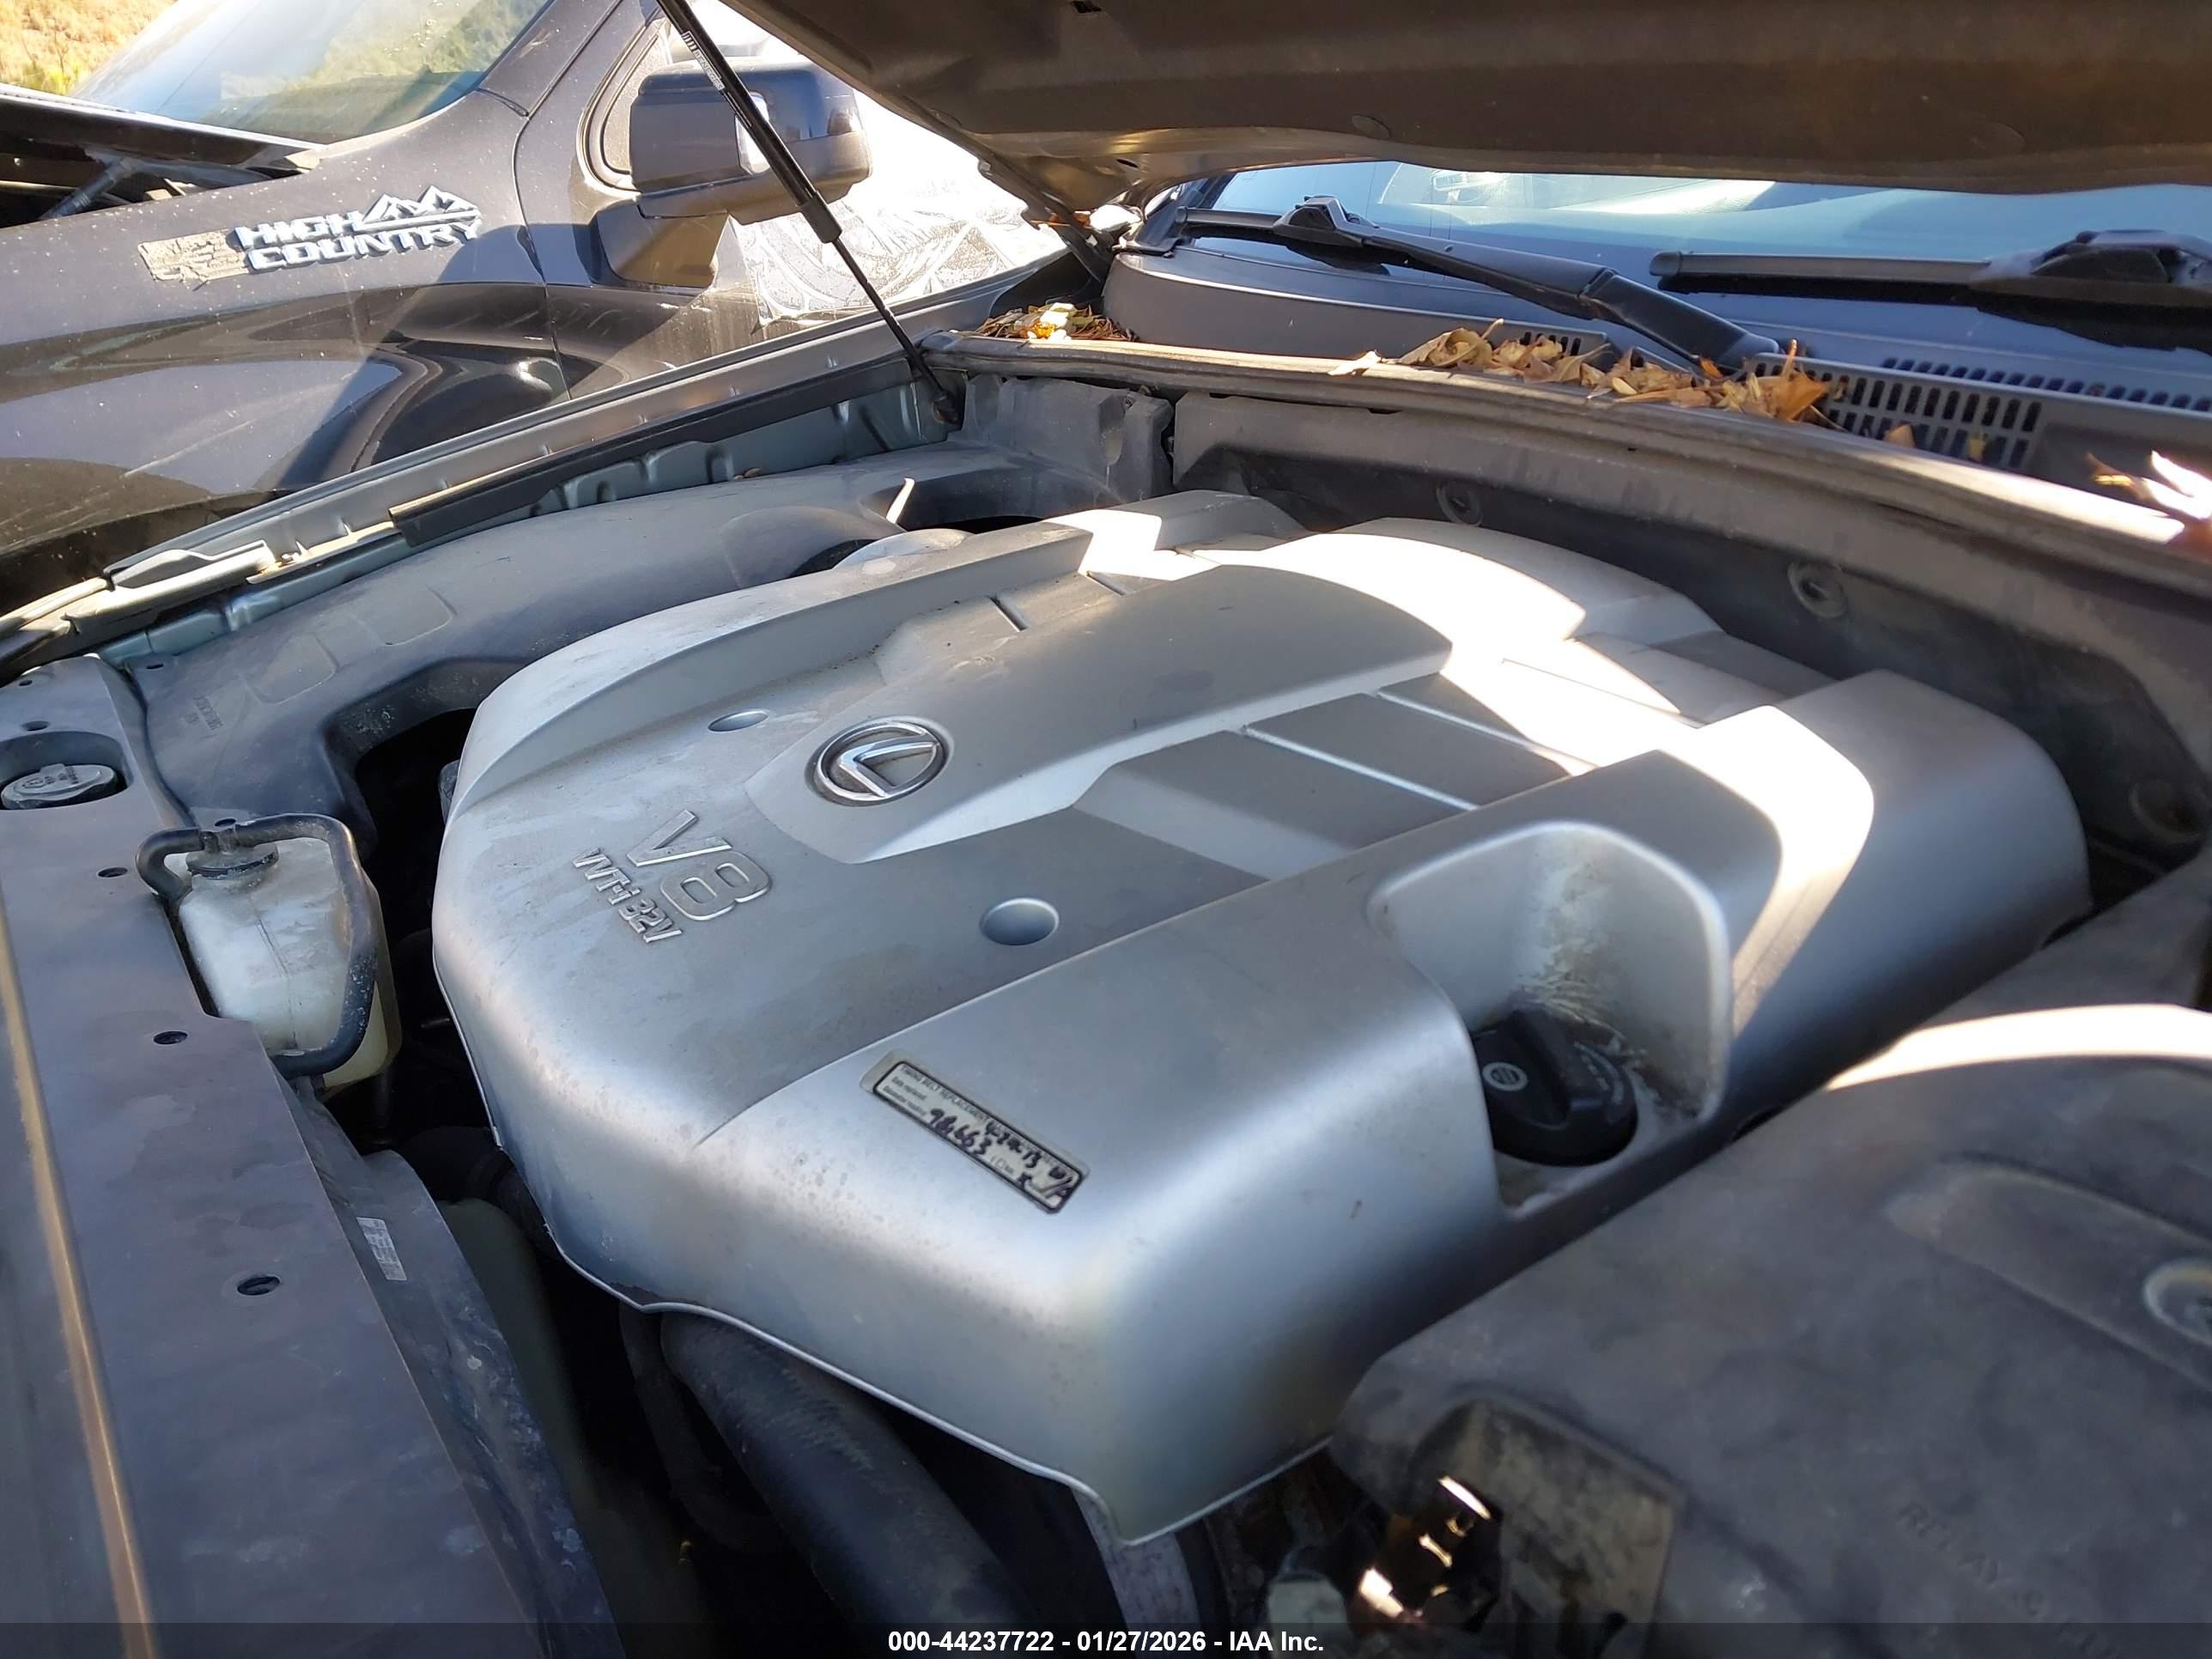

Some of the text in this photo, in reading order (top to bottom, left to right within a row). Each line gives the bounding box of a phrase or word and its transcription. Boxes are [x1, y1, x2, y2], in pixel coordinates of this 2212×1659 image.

[234, 210, 364, 249] HIGH
[246, 218, 483, 273] COUNTRY
[627, 809, 771, 921] V8
[573, 848, 684, 943] VVT-i 32V
[921, 1076, 942, 1092] BELT
[939, 1087, 989, 1123] REPLACEMENT
